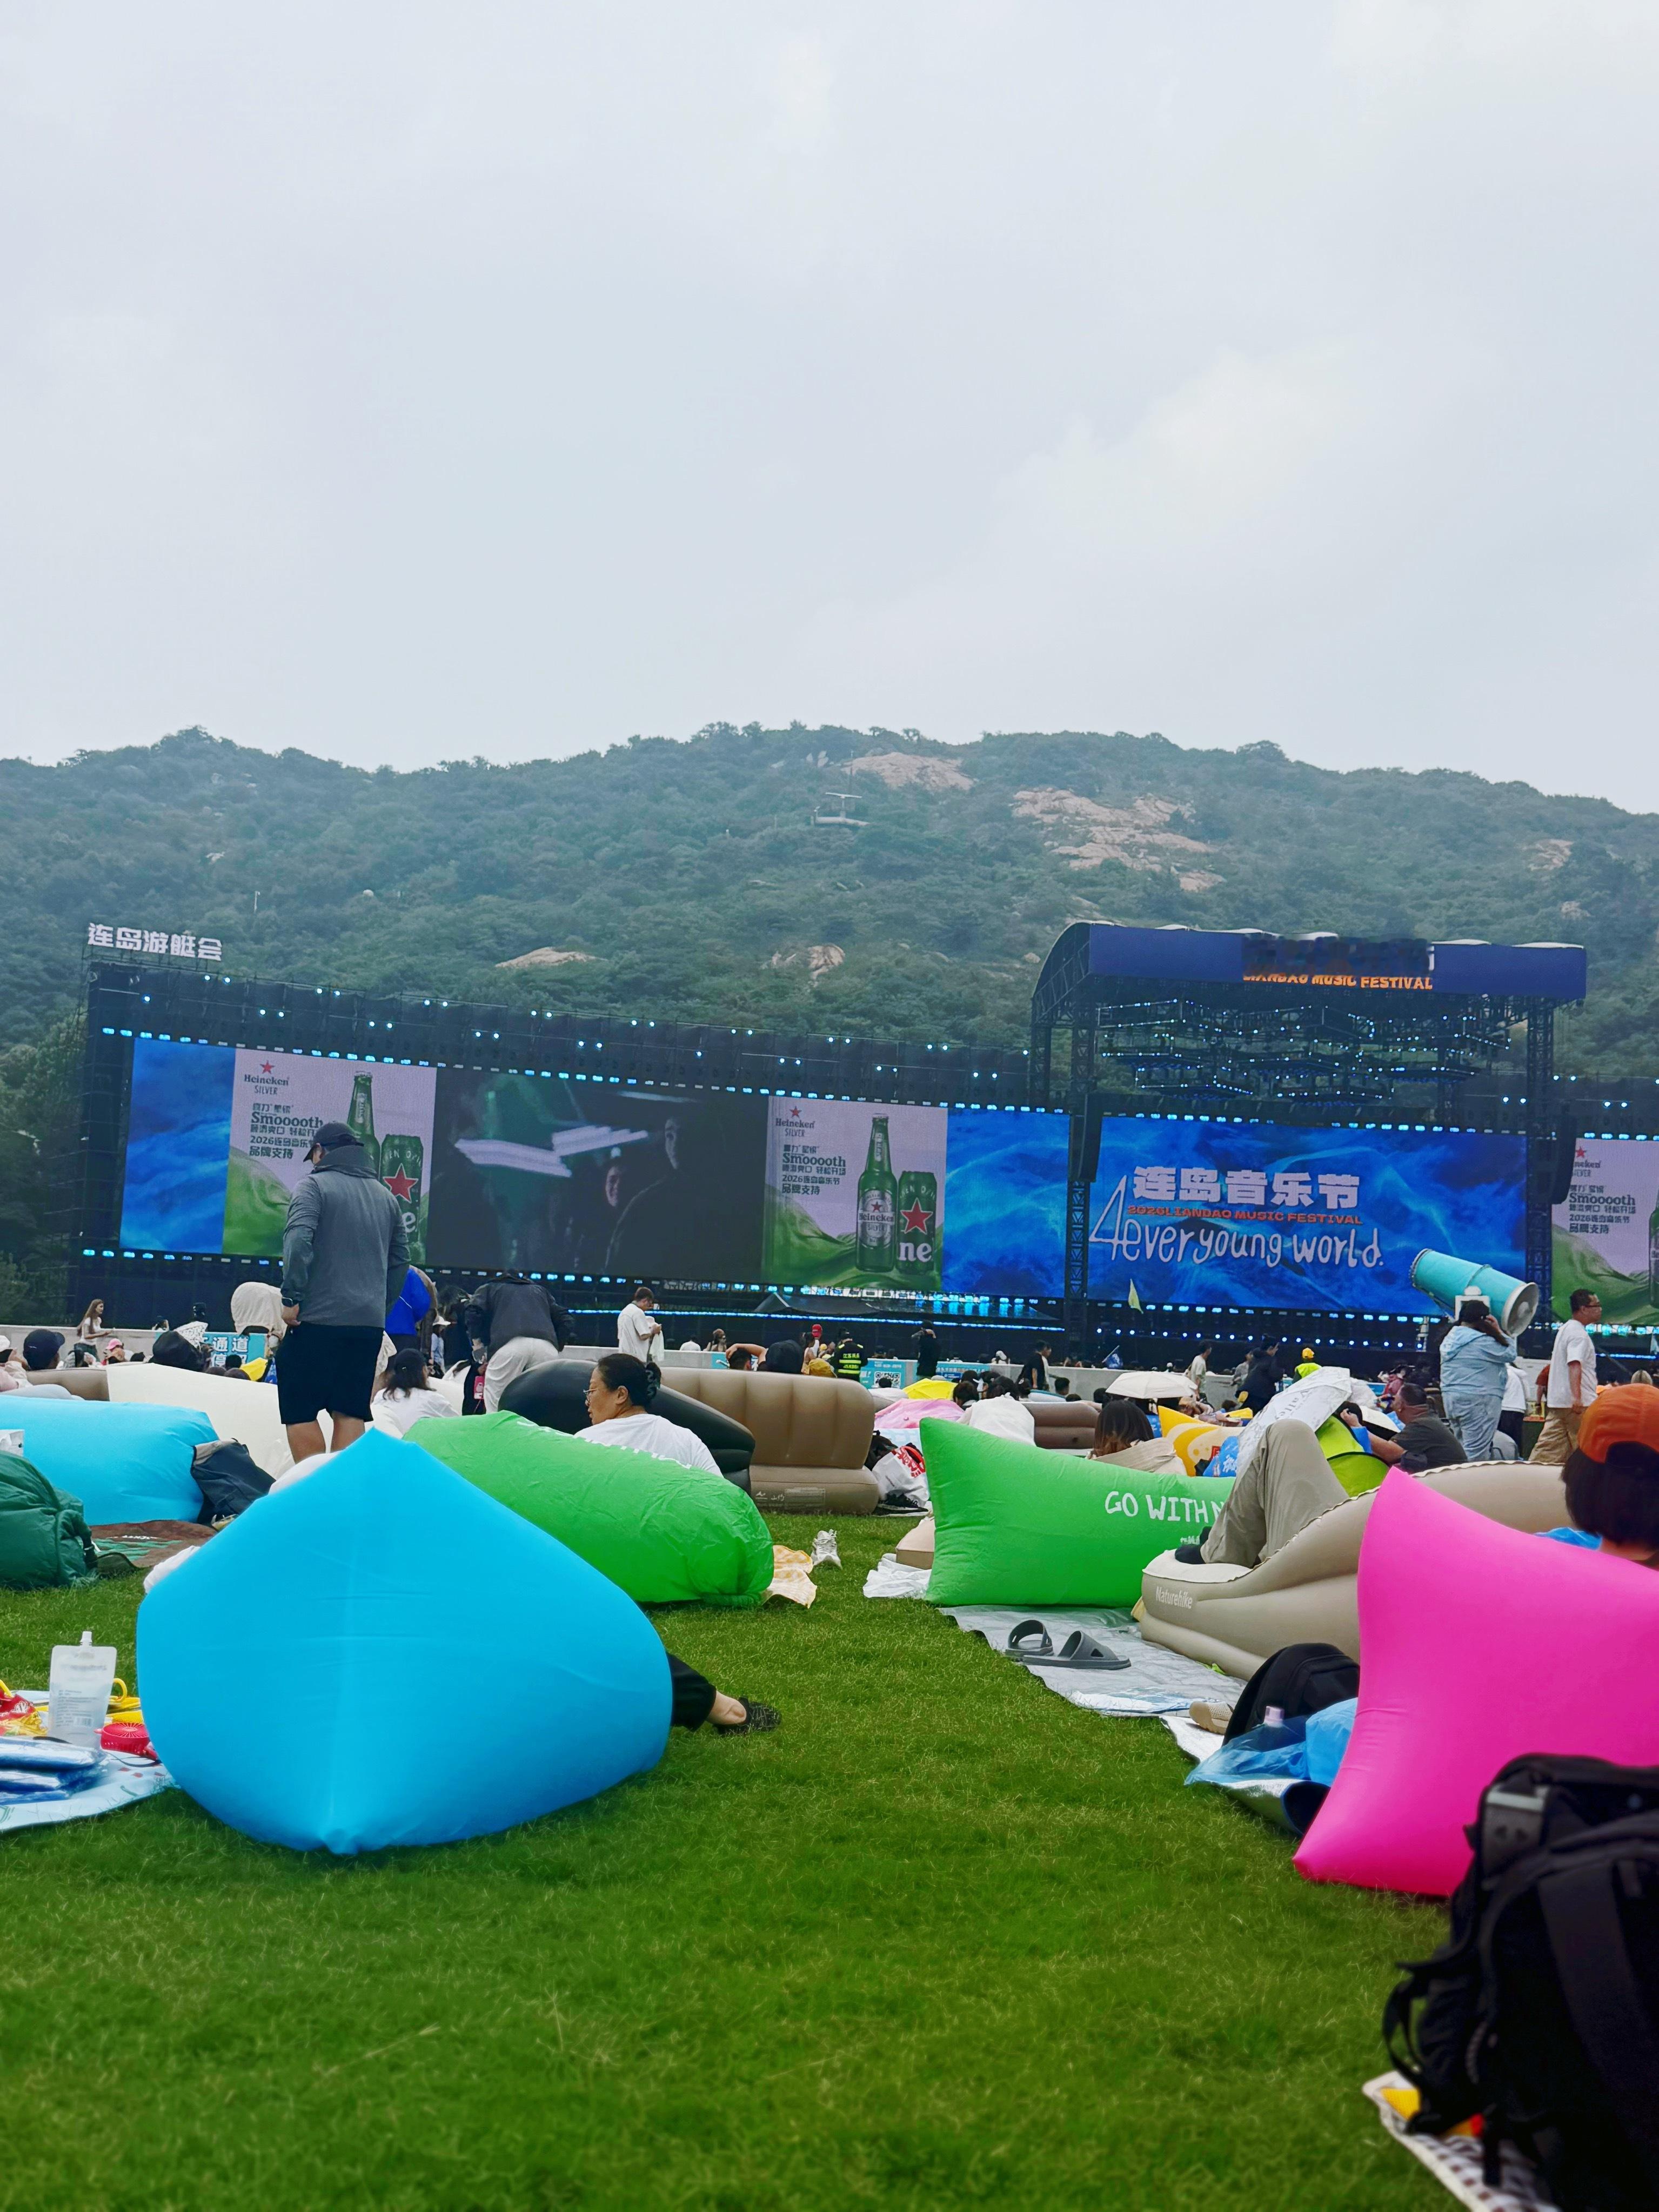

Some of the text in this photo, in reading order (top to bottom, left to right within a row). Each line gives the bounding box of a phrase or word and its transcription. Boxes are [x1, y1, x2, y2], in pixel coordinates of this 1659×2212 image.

[88, 922, 222, 961] 连岛游艇会
[1312, 975, 1357, 987] MUSIC
[1360, 976, 1433, 990] FESTIVAL
[244, 1074, 289, 1086] Heineken
[254, 1085, 278, 1095] SILVER
[251, 1111, 323, 1128] Smooooth
[775, 1118, 814, 1128] Heineken
[785, 1128, 805, 1137] SILVER
[249, 1145, 294, 1159] 品牌支持
[782, 1152, 846, 1167] Smooooth
[782, 1183, 820, 1195] 品牌支持
[1133, 1166, 1360, 1210] 连岛音乐节
[1569, 1192, 1636, 1205] Smooooth
[1235, 1210, 1284, 1221] MUSIC
[1287, 1213, 1363, 1225] FESTIVAL
[1105, 1491, 1139, 1517] GO
[1145, 1494, 1209, 1523] WITH
[1155, 1586, 1193, 1609] Naturehike
